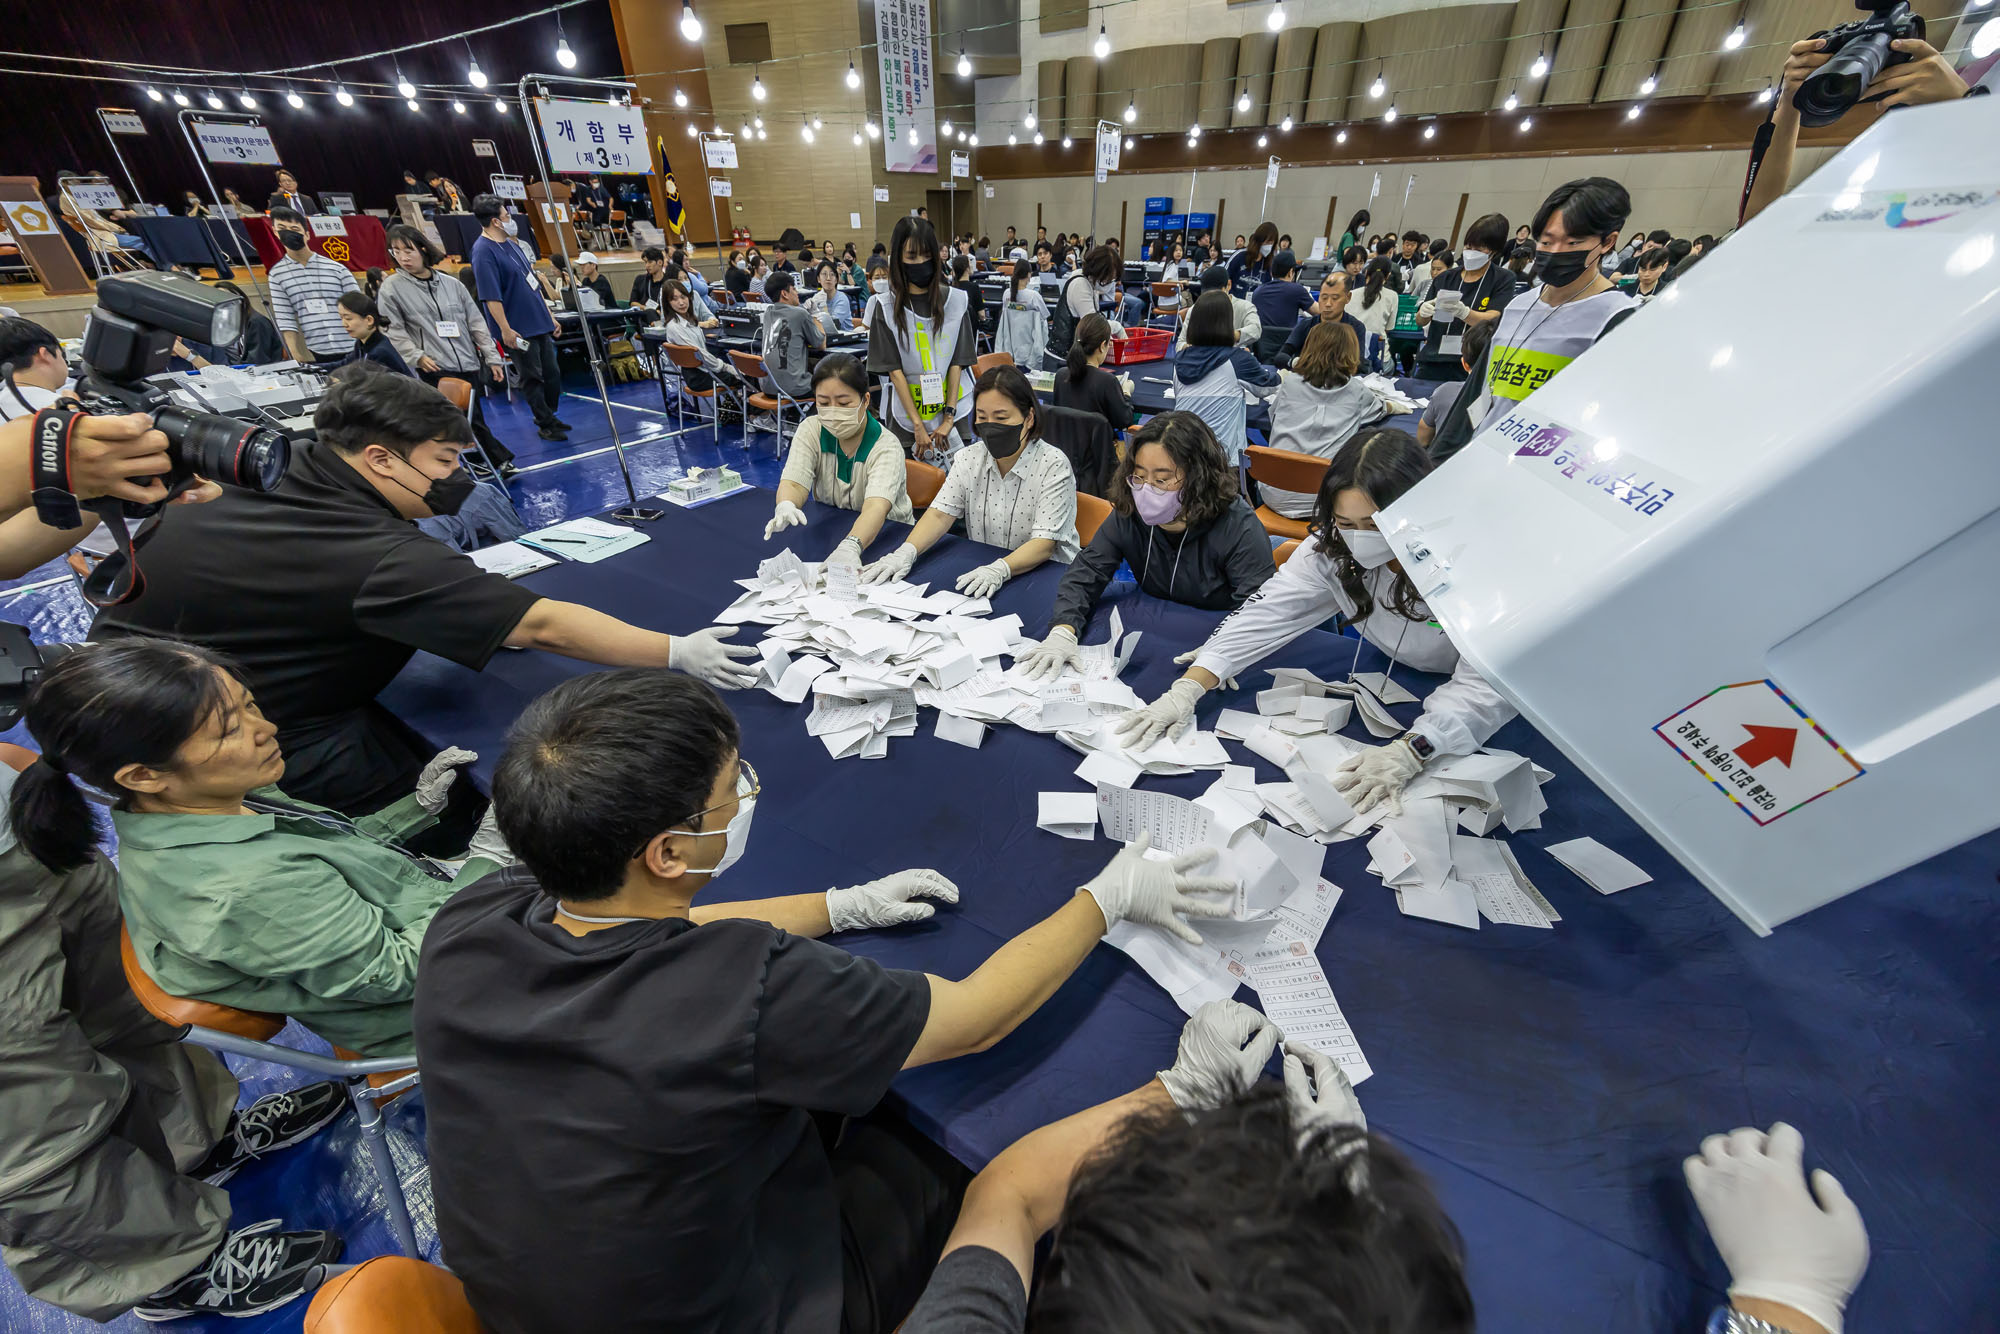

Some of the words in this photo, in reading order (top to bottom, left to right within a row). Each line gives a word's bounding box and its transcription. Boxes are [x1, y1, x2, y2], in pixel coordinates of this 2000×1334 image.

[1864, 23, 1885, 31] Canon
[921, 64, 929, 90] 중구
[895, 89, 904, 116] 중구
[905, 91, 913, 117] 중구
[914, 78, 922, 105] 중구
[201, 134, 271, 147] 투표지분류기운영부
[888, 116, 896, 142] 중구
[1746, 161, 1758, 194] Canon
[314, 222, 342, 231] 위원장
[41, 416, 63, 474] Canon
[1676, 720, 1710, 749] 주세요
[1728, 768, 1755, 789] 잡고
[1747, 784, 1776, 811] 이곳을
